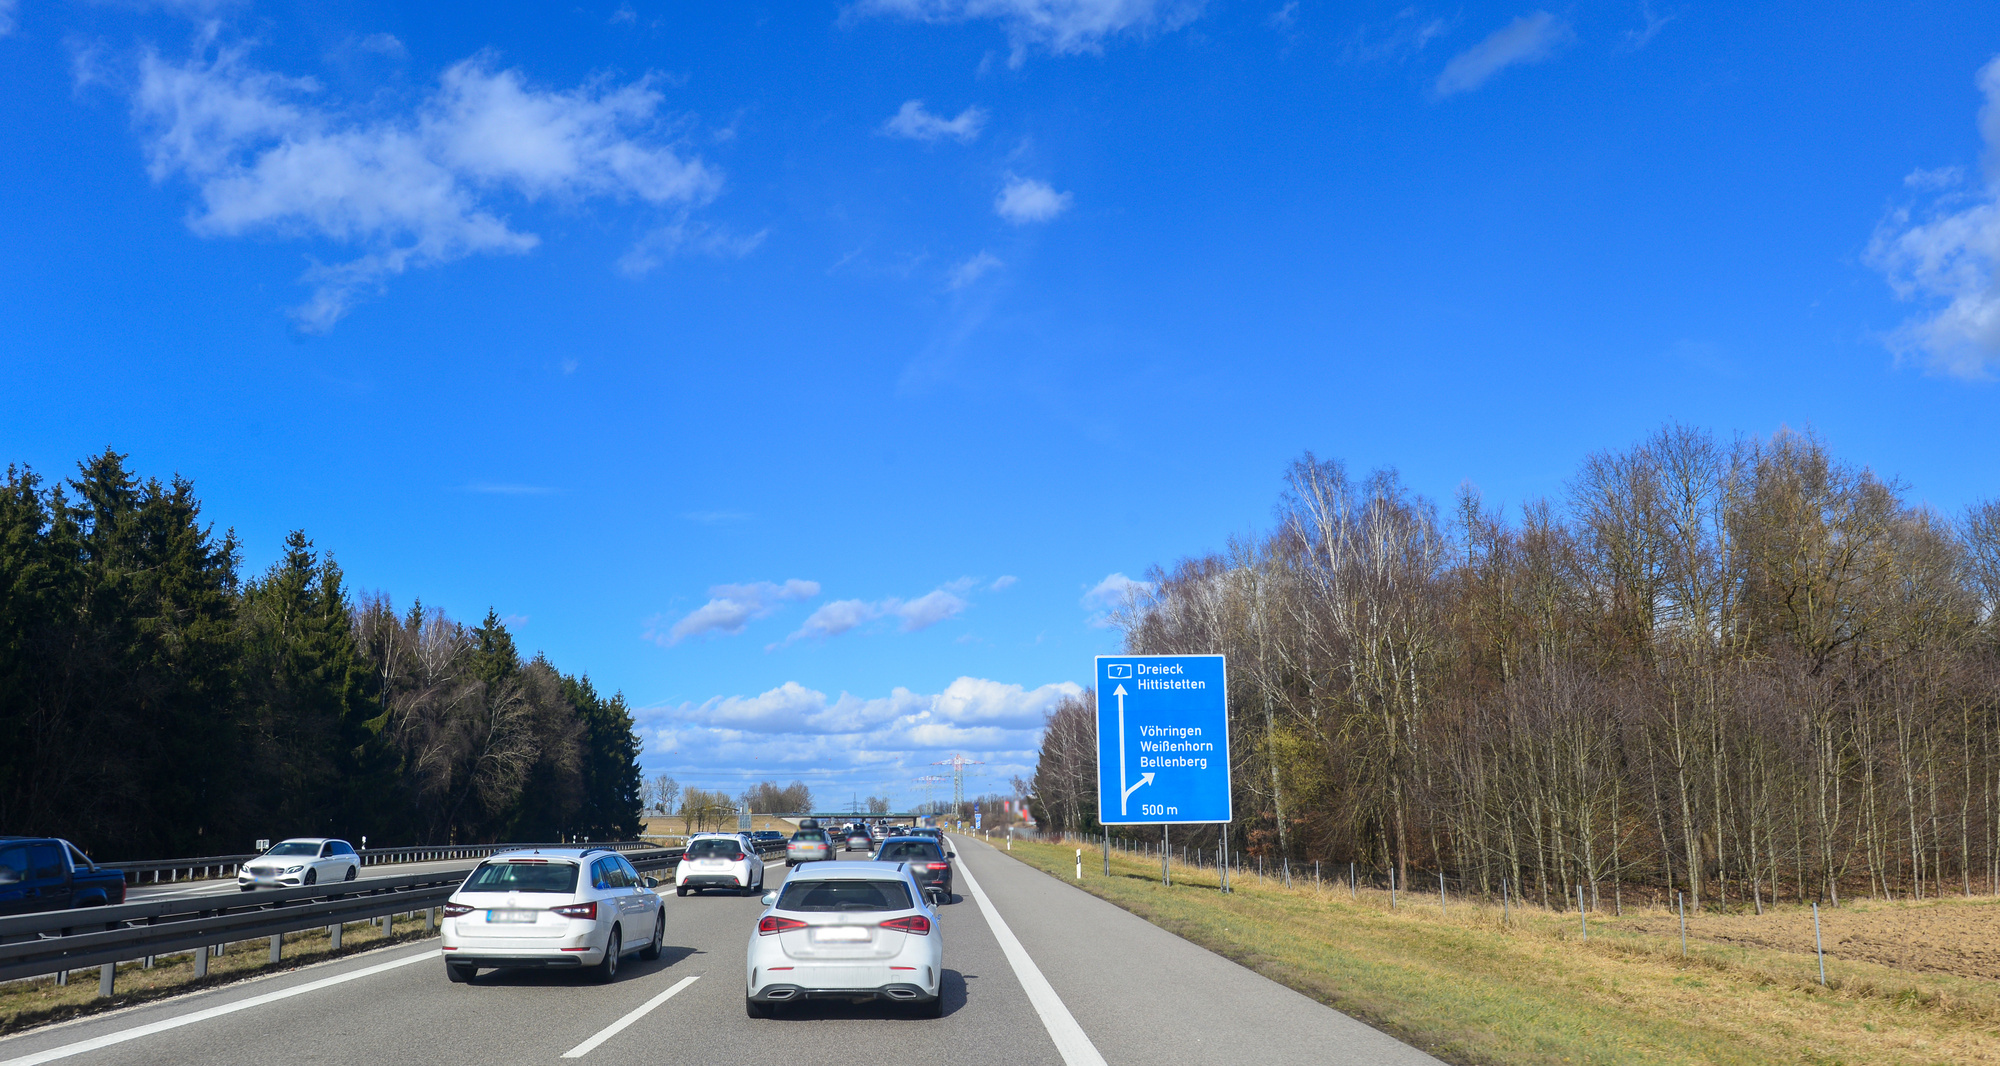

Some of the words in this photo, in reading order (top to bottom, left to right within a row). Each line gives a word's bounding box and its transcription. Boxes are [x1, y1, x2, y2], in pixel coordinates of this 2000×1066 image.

[1138, 664, 1184, 675] Dreieck
[1138, 679, 1206, 690] Hittistetten
[1140, 726, 1202, 739] Vöhringen
[1140, 741, 1213, 752] Weißenhorn
[1140, 756, 1207, 769] Bellenberg
[1142, 805, 1164, 815] 500
[1166, 807, 1178, 815] m
